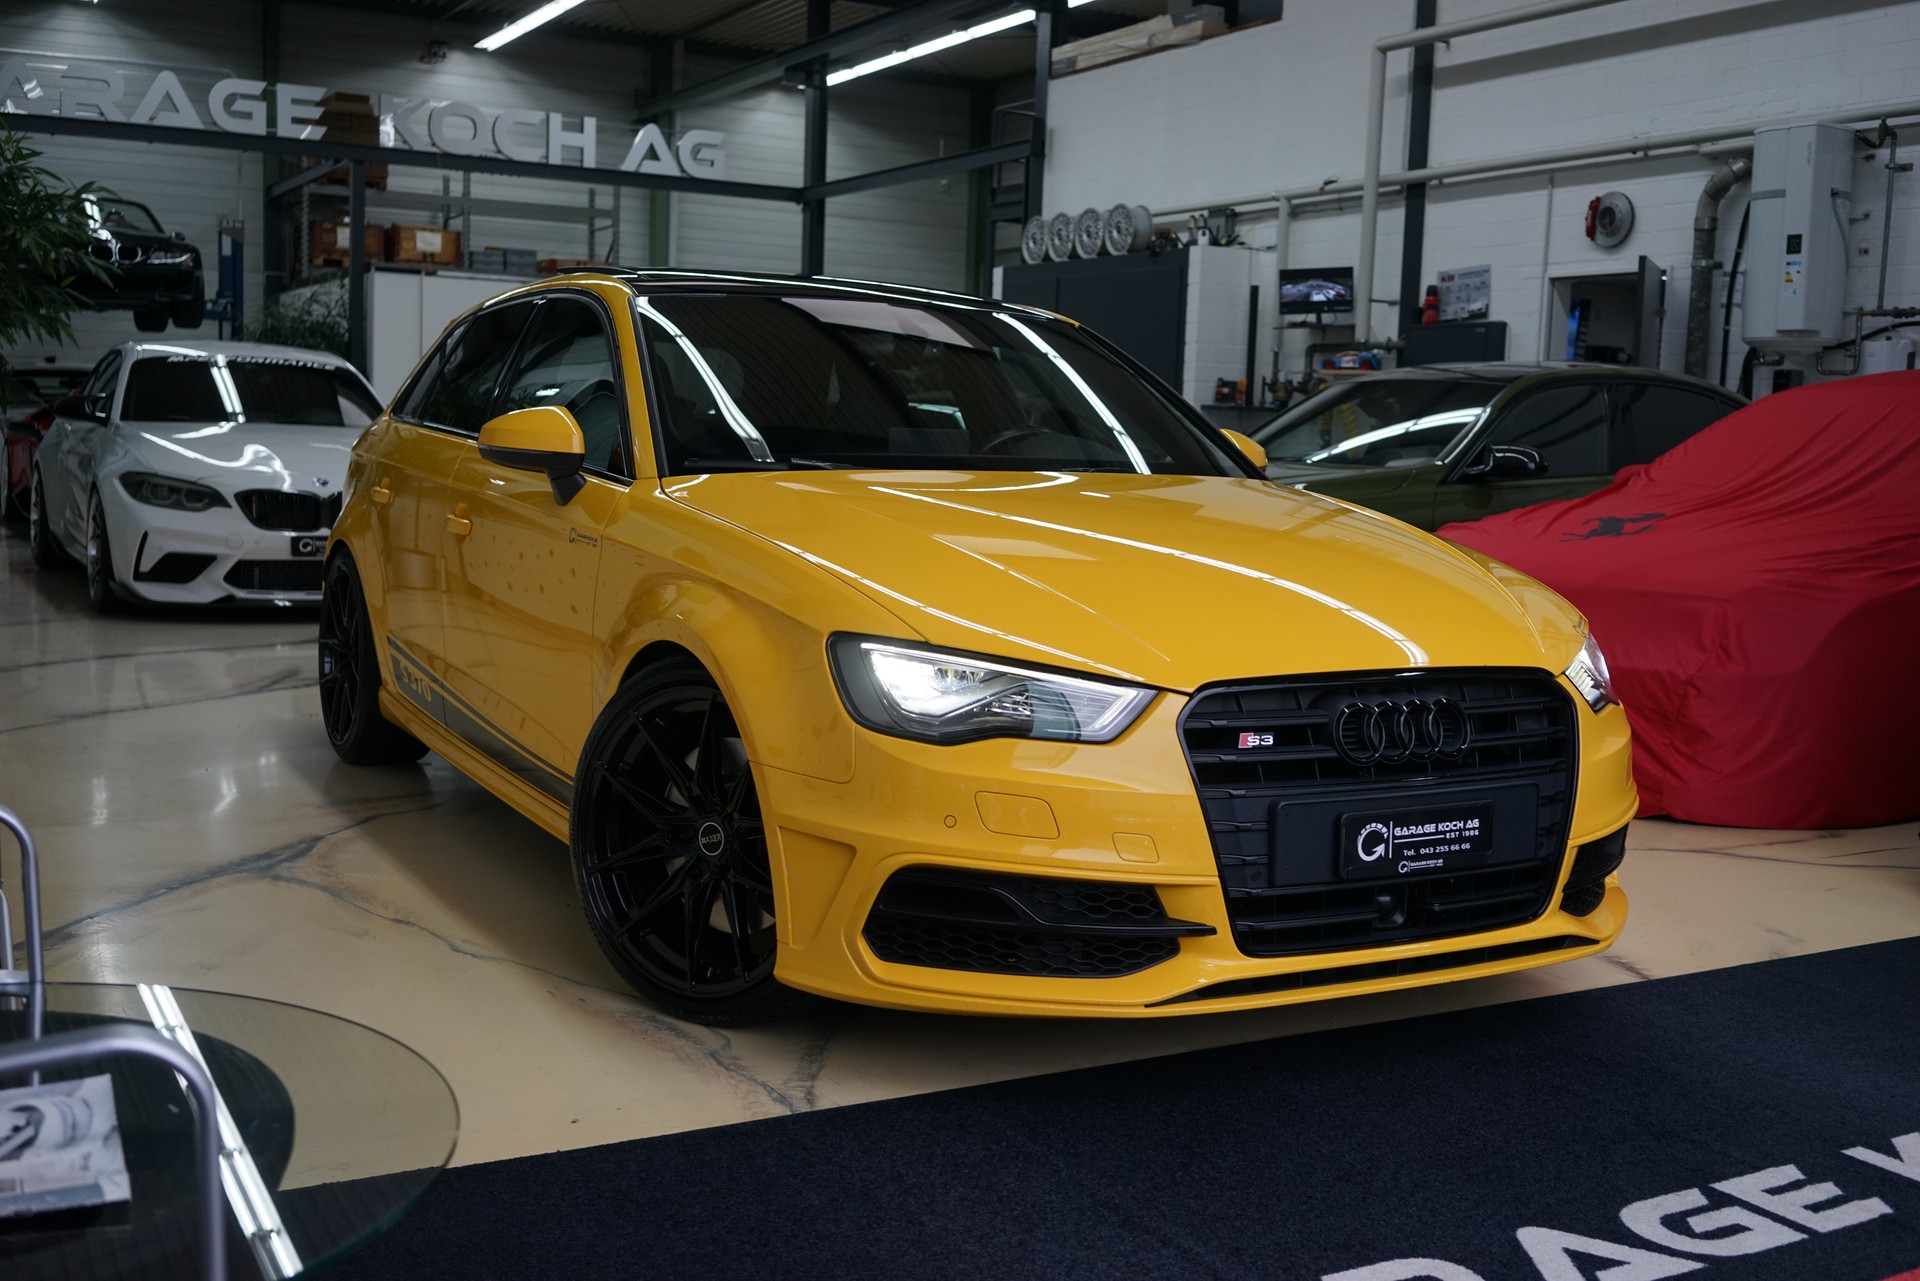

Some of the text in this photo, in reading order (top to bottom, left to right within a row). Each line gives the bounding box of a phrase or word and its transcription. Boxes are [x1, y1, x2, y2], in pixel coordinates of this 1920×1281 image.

[379, 94, 597, 168] KOCH
[620, 122, 727, 181] AG
[1247, 735, 1274, 746] S3
[1393, 818, 1480, 836] GARAGE KOCH AG
[1445, 829, 1480, 839] EST 1986
[1420, 846, 1434, 855] 043
[1435, 844, 1449, 853] 255
[1450, 843, 1460, 851] 66
[1461, 842, 1471, 850] 66
